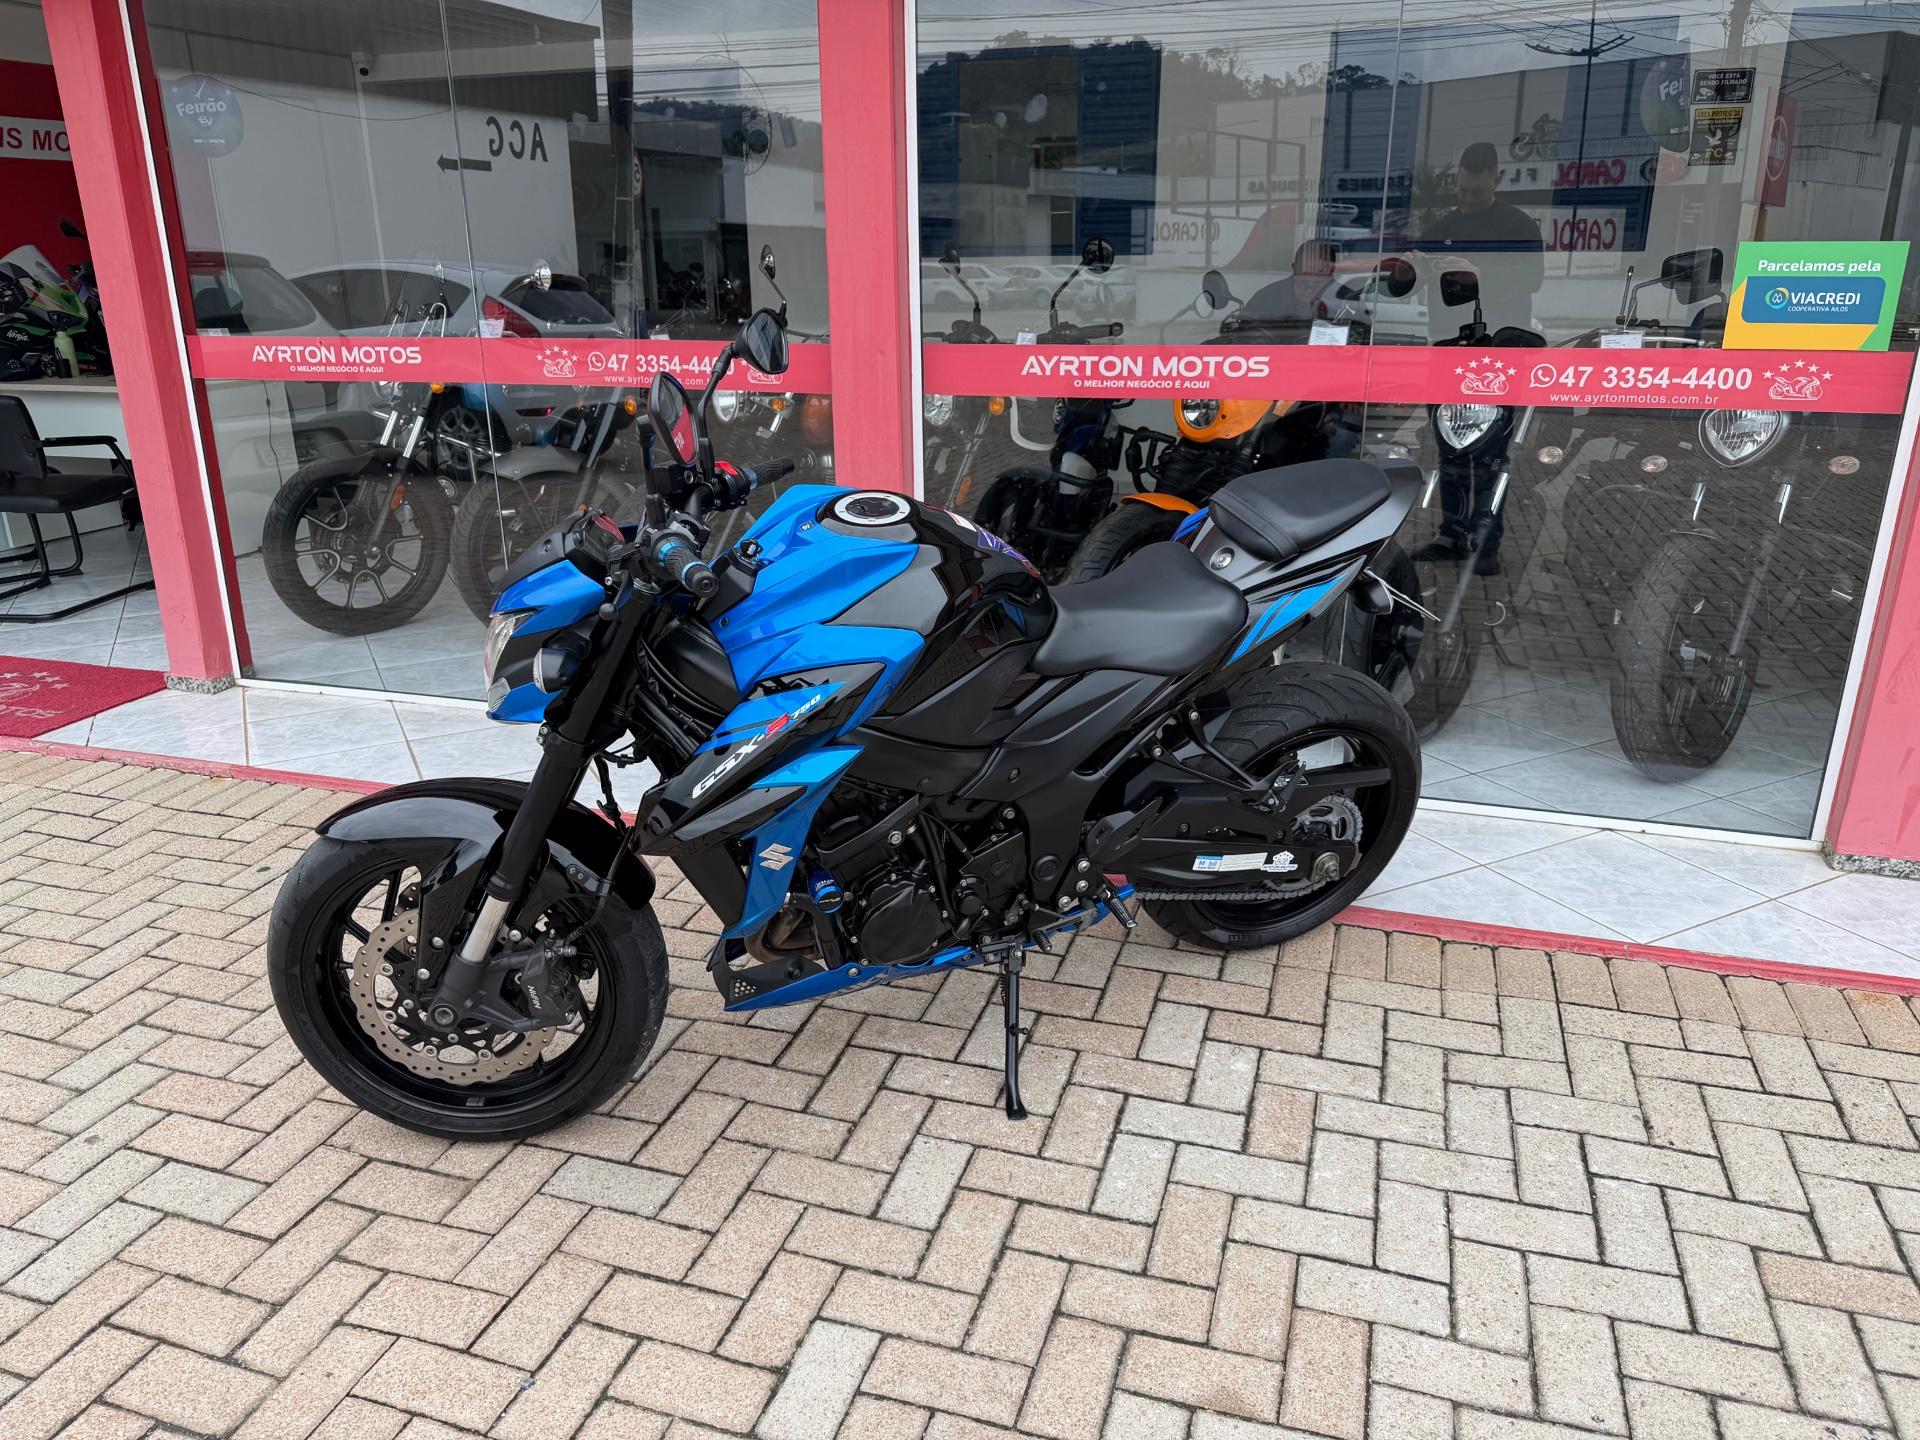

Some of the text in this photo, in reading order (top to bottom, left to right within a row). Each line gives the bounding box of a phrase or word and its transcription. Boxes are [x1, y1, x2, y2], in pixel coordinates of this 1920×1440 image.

[1659, 78, 1685, 101] Fei
[176, 97, 226, 117] Feirão
[32, 129, 70, 152] MO
[1758, 260, 1881, 275] Parcelamos pela
[1791, 292, 1861, 305] VIACREDI
[252, 345, 422, 364] AYRTON MOTOS
[607, 353, 734, 375] 47 3354-44
[327, 365, 358, 373] NEGÓCIO
[1021, 355, 1270, 378] AYRTON MOTOS
[604, 374, 711, 387] www.ayrto.com.
[1074, 379, 1210, 389] O MELHOR NEGÓCIO É AQUI
[1559, 366, 1753, 390] 47 3354-4400
[1550, 393, 1719, 405] www.ayrtonmotos.com.br
